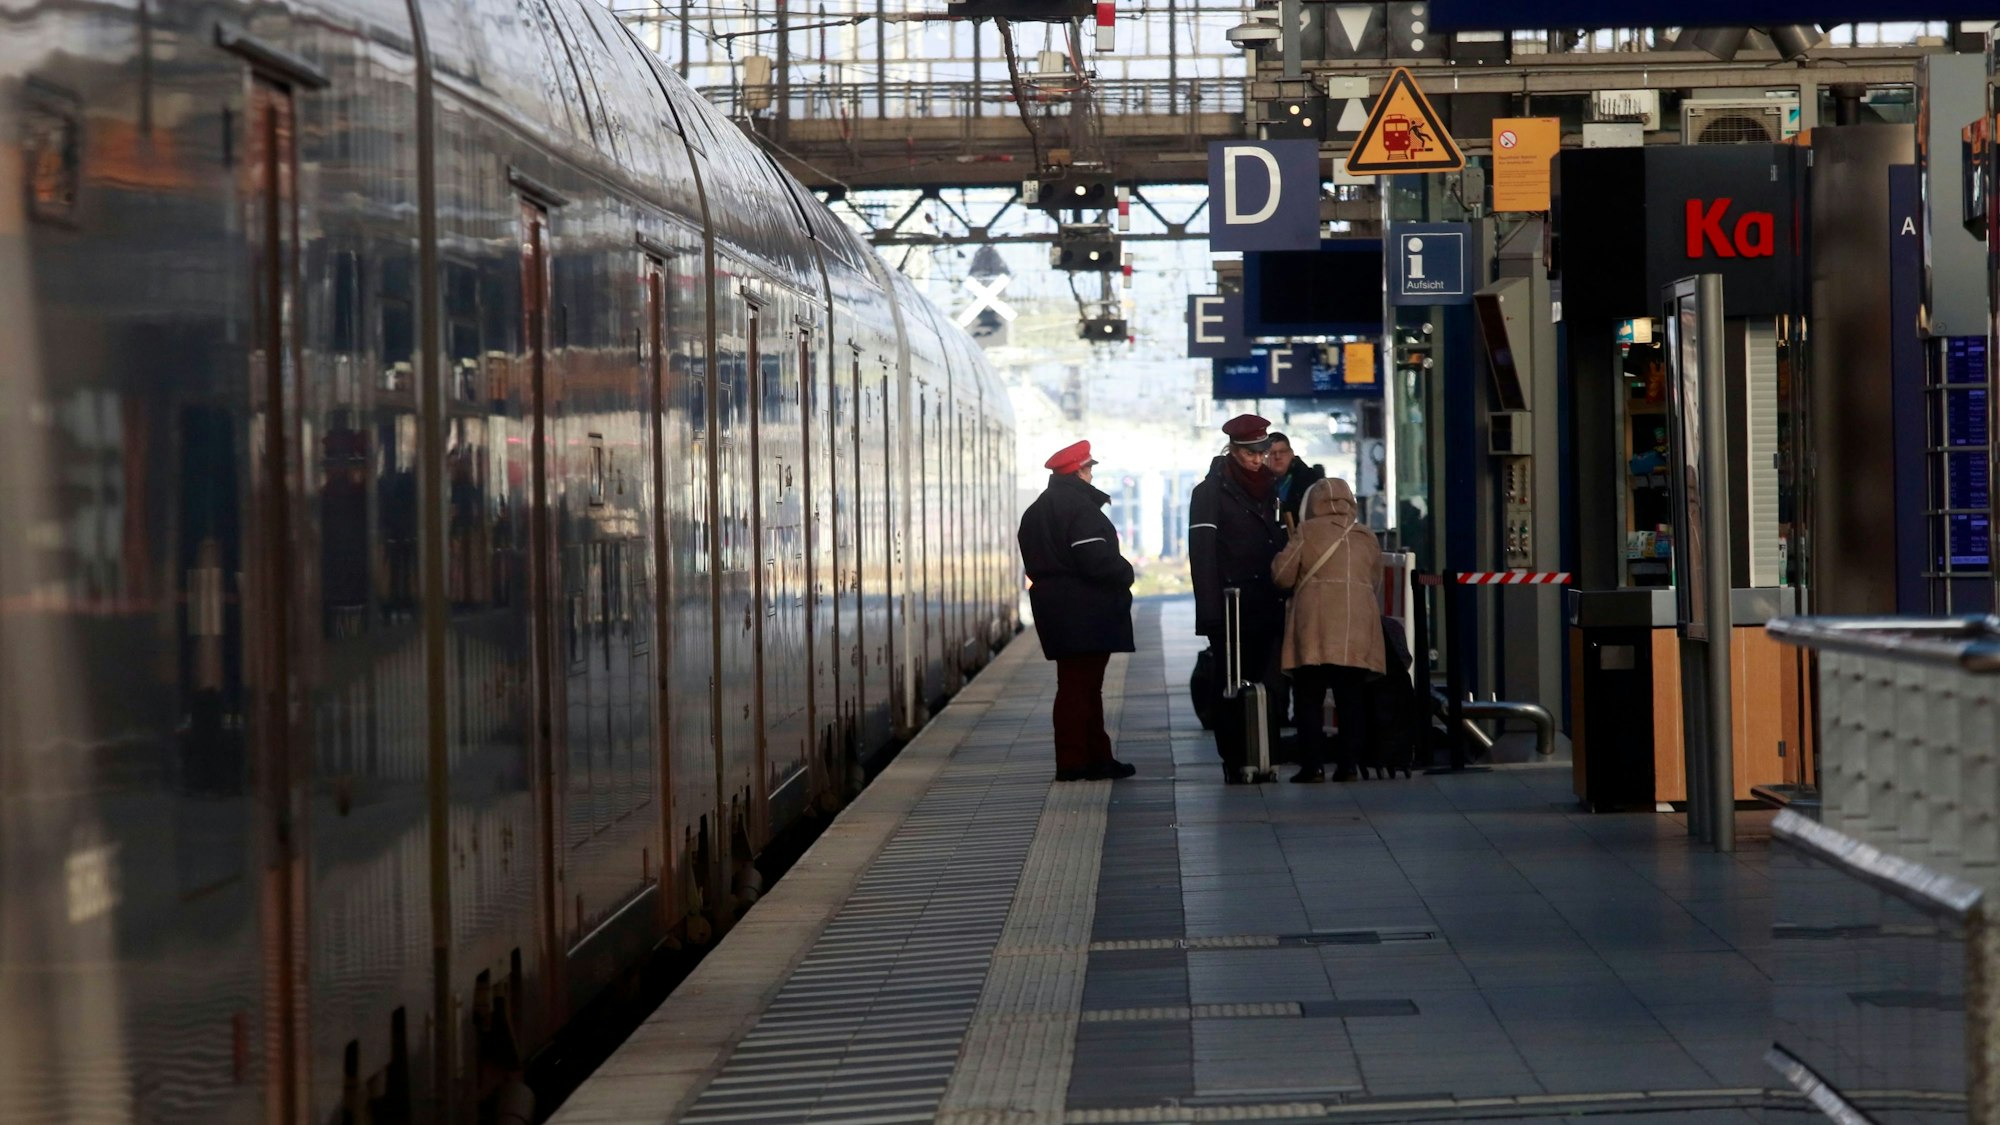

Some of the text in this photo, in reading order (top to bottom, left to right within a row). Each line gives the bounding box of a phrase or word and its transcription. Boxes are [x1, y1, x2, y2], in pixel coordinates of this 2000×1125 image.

[1223, 145, 1282, 225] D
[1406, 280, 1445, 289] Aufsicht
[1195, 296, 1226, 344] E
[1271, 349, 1293, 384] F
